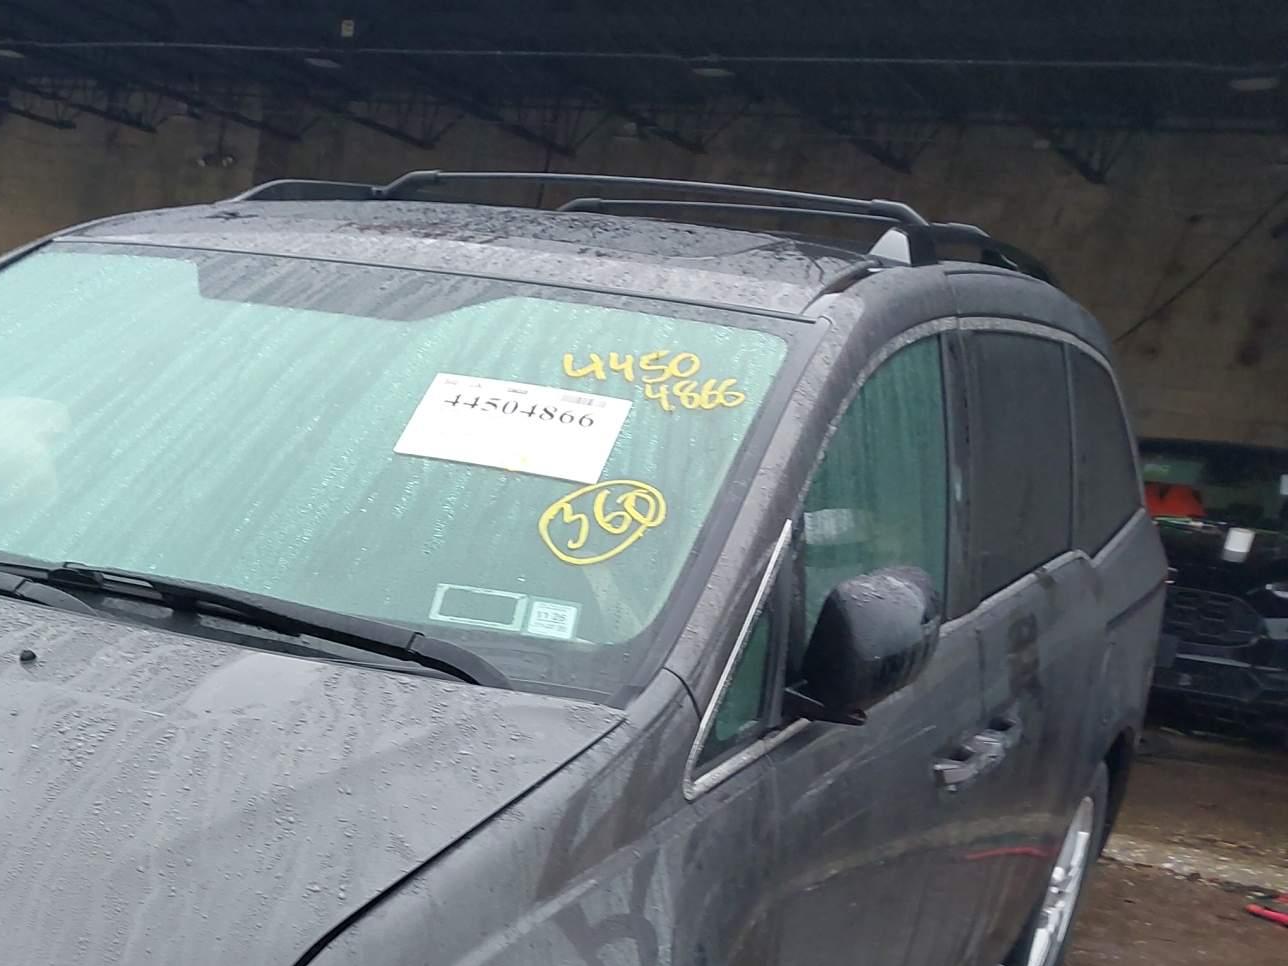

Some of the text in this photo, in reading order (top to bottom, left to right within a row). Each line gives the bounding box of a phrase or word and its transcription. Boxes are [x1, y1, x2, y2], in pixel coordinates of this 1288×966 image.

[563, 350, 701, 384] 4450
[444, 393, 594, 428] 44504866
[643, 378, 745, 412] 4866
[548, 489, 657, 550] 360
